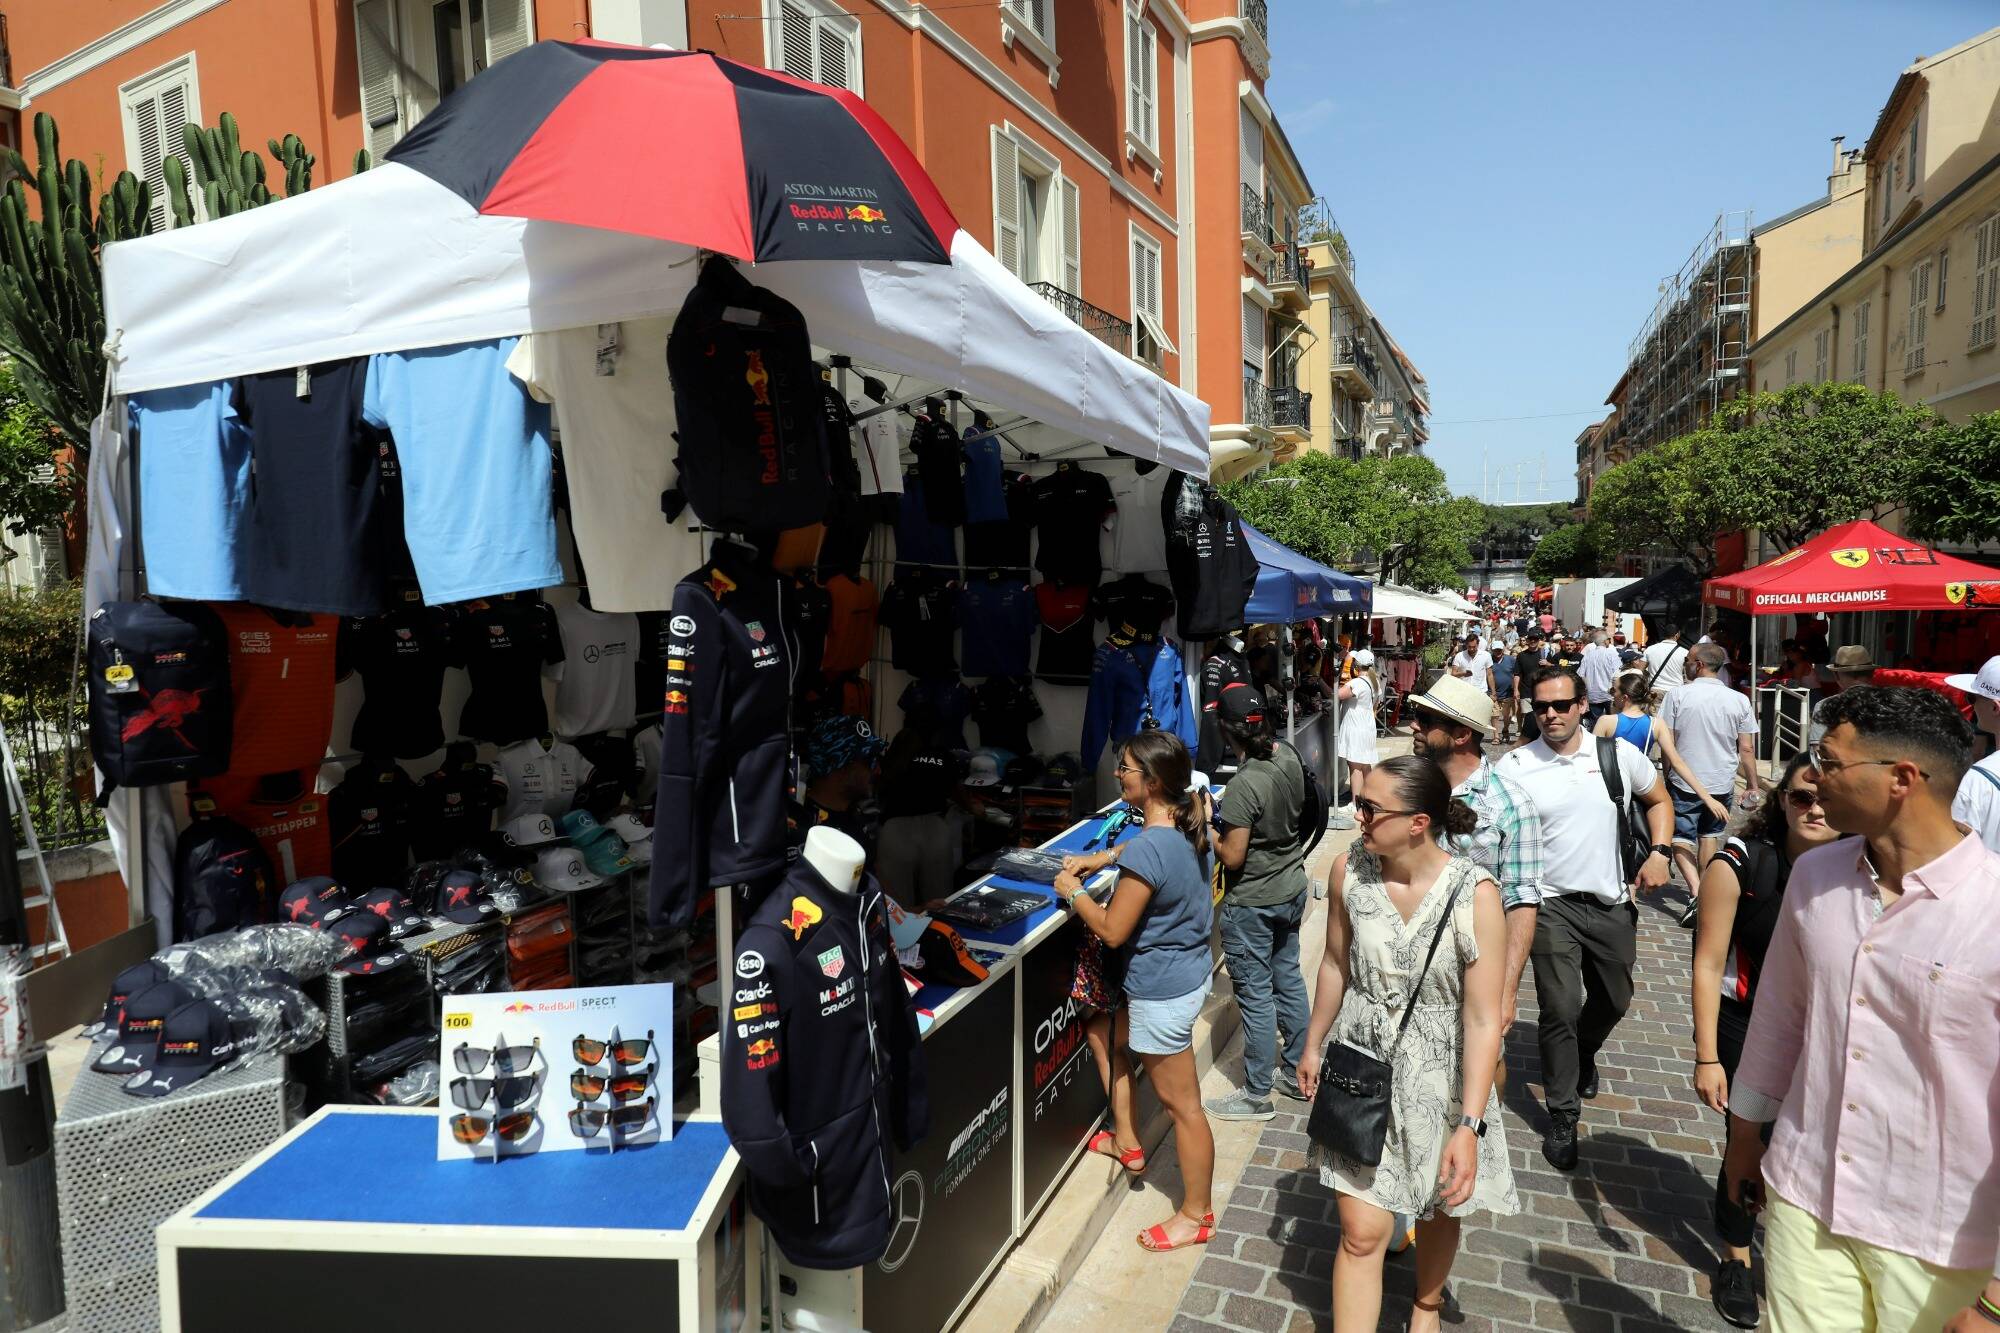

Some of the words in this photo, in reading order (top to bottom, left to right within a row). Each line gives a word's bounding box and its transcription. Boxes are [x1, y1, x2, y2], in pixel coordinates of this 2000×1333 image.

[784, 183, 825, 197] ASTON
[829, 185, 878, 199] MARTIN
[797, 222, 892, 234] RACING
[770, 350, 800, 482] RACIN
[1756, 592, 1802, 605] OFFICIAL
[1805, 589, 1887, 604] MERCHANDISE
[739, 957, 761, 971] Esso
[820, 950, 841, 963] TAG
[735, 982, 772, 1003] Claro
[821, 993, 856, 1017] ORACLE
[969, 1086, 1008, 1133] AMG
[932, 1105, 1008, 1194] PETRONAS
[945, 1157, 977, 1198] FORMULA
[978, 1139, 991, 1161] ONE
[992, 1122, 1008, 1145] TEAM
